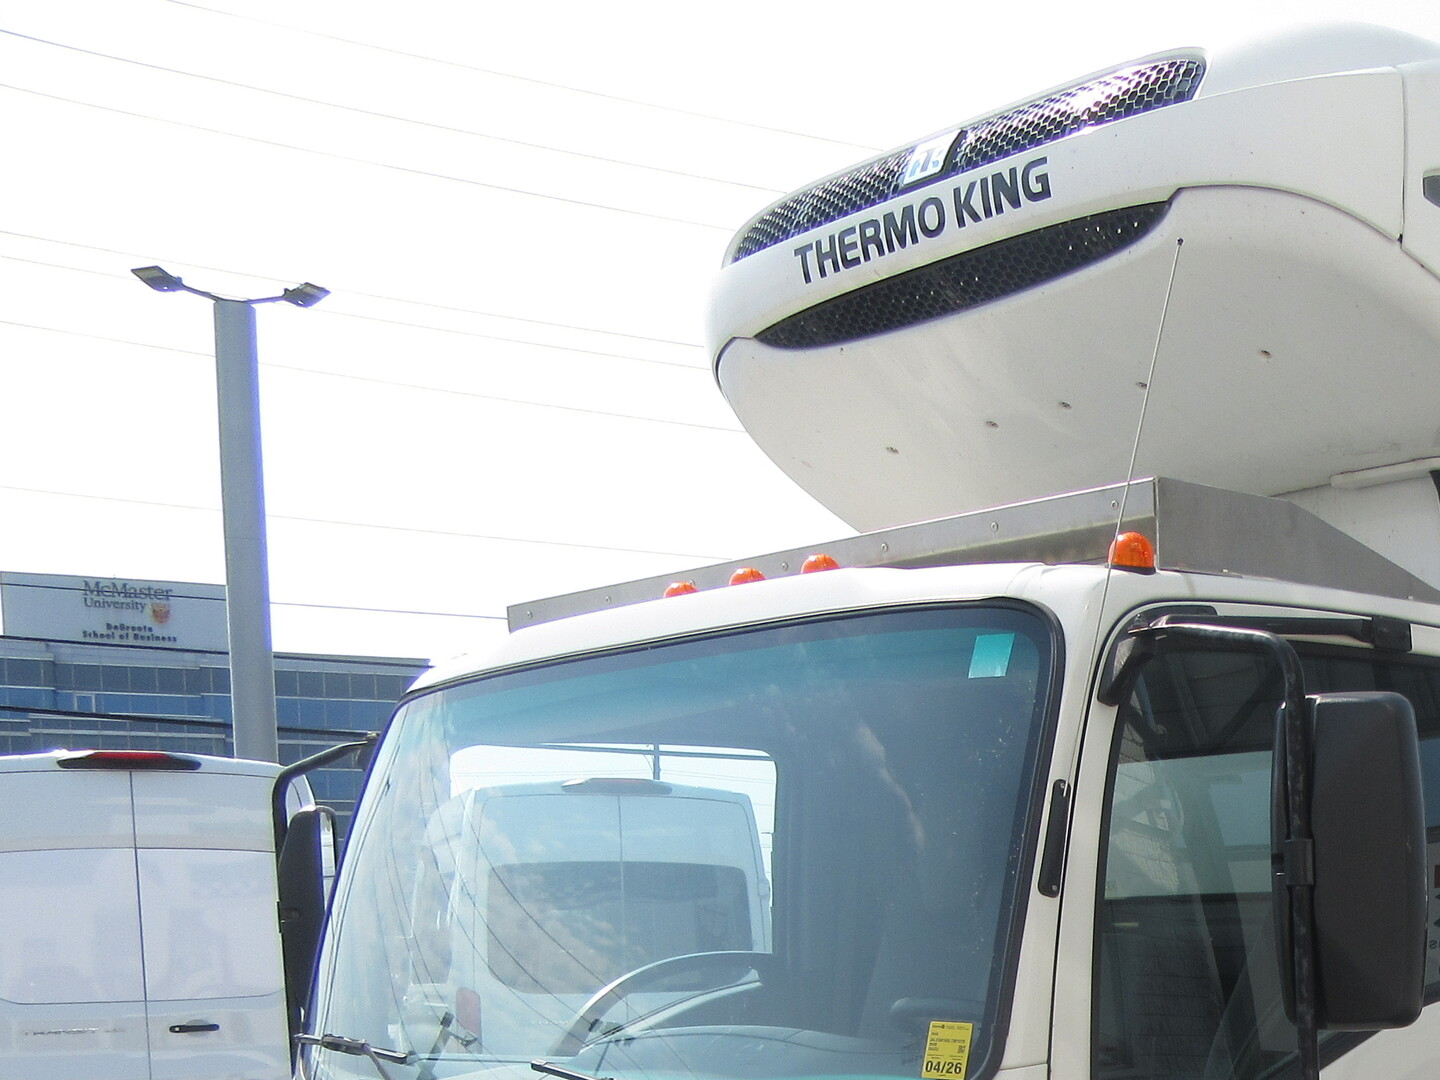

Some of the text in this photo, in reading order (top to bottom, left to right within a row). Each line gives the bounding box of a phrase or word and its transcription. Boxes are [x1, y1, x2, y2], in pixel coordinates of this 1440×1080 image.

[794, 156, 1052, 285] THERMO KING
[82, 580, 173, 600] McMaster
[83, 597, 146, 613] University
[82, 630, 177, 642] School of Business
[925, 1060, 962, 1075] 04/26
